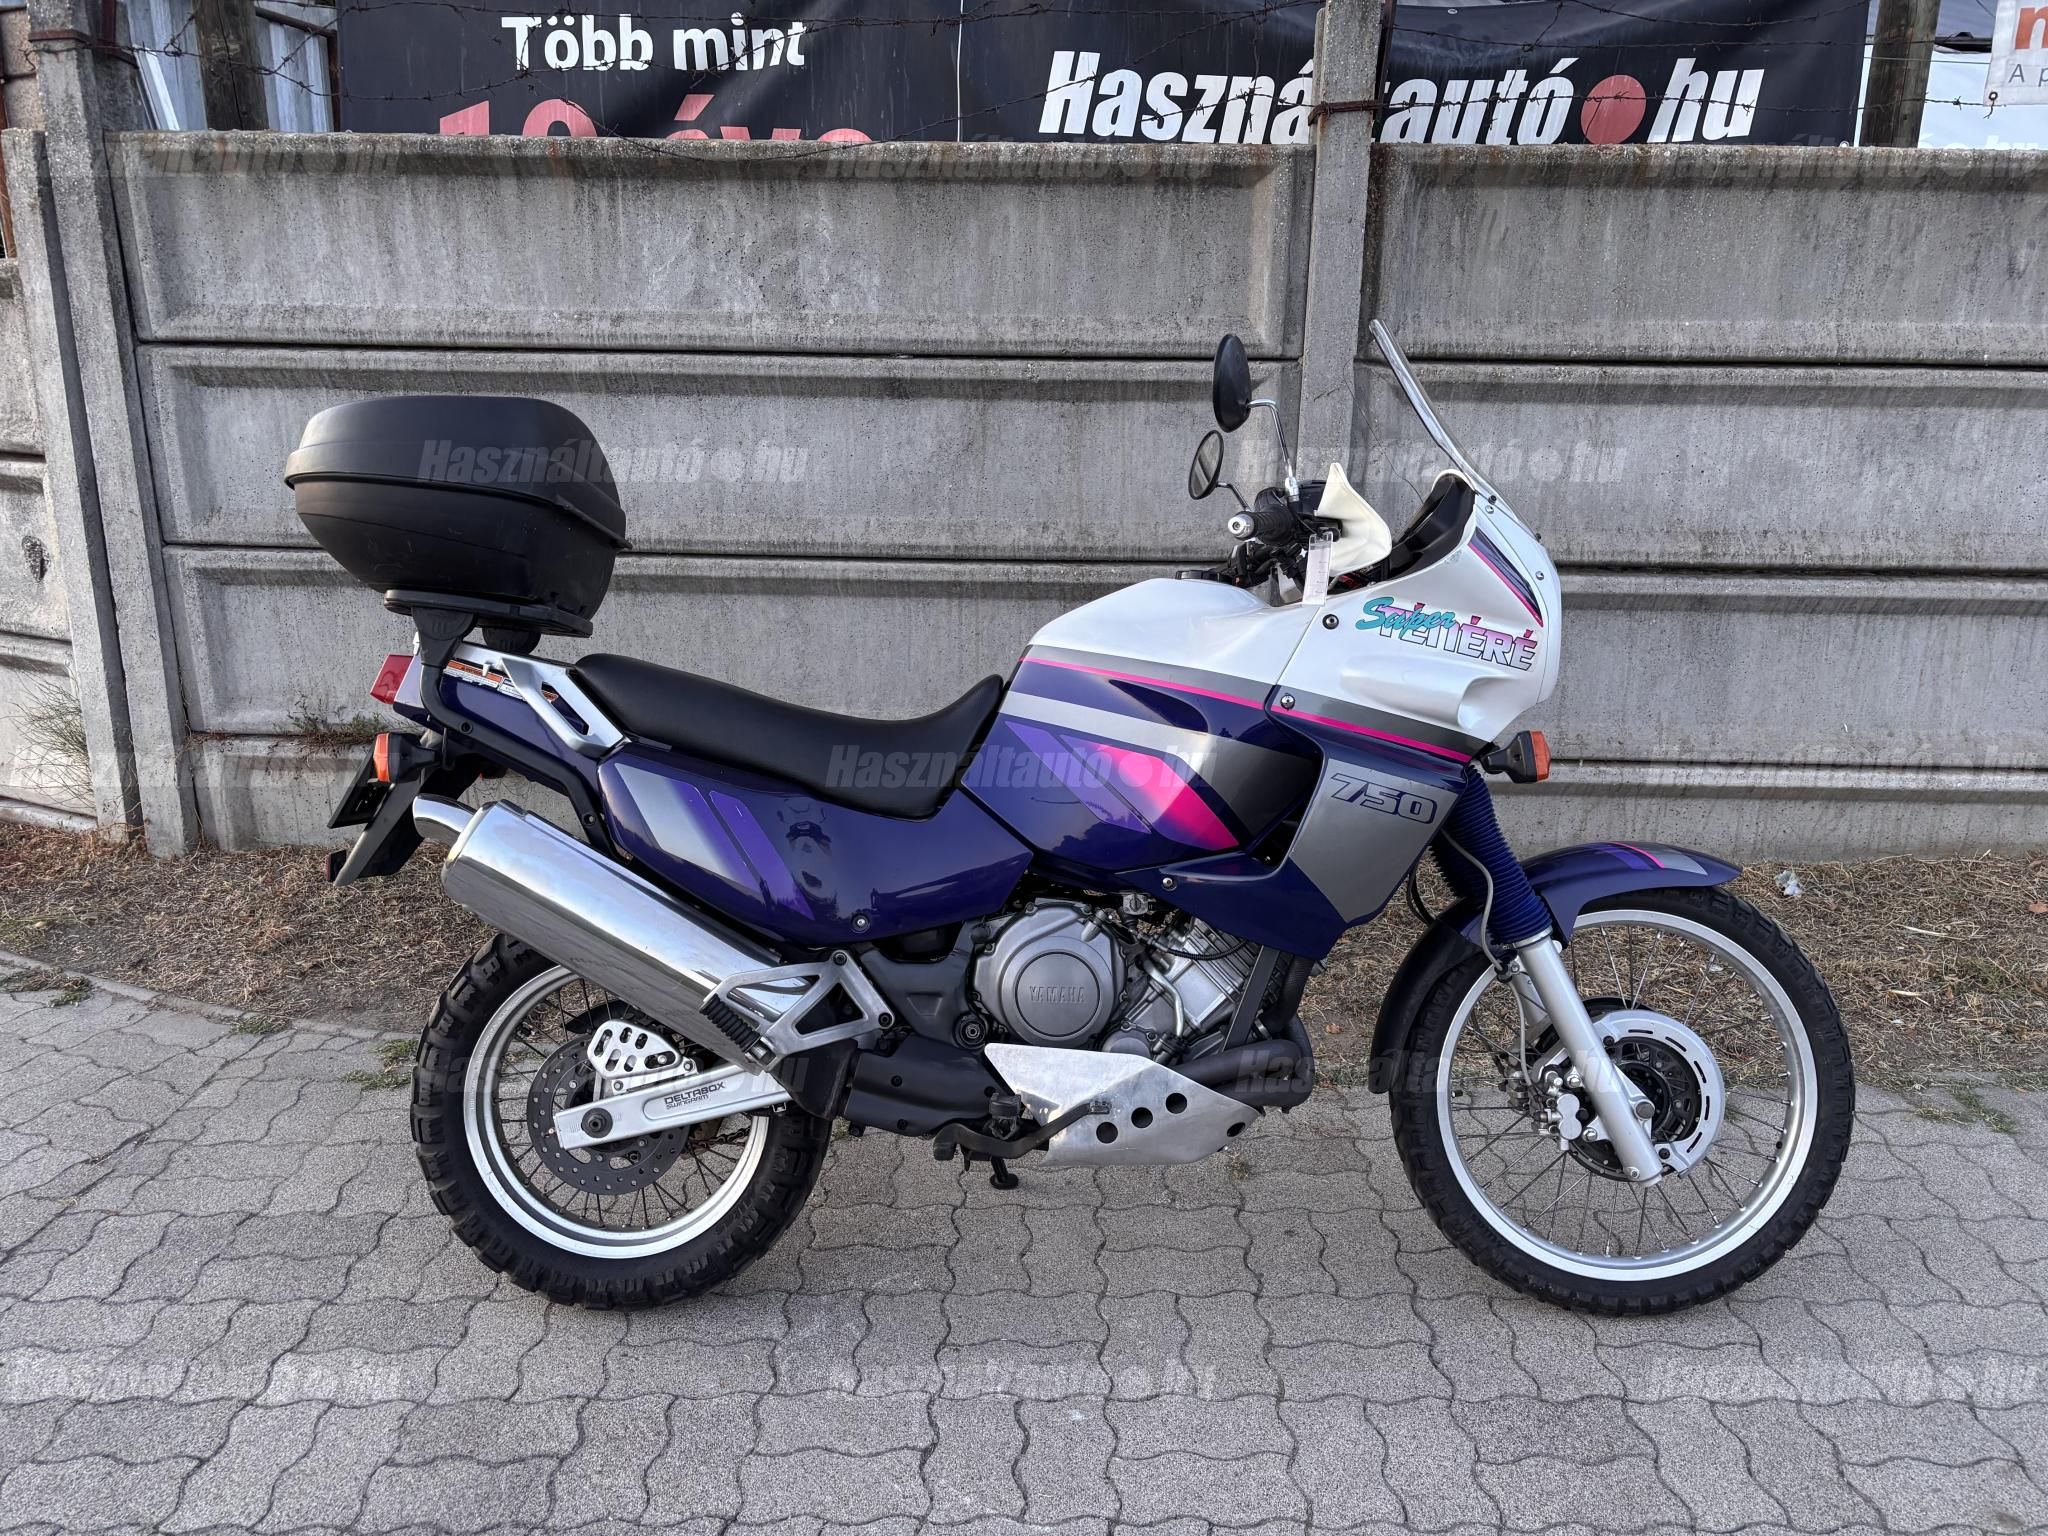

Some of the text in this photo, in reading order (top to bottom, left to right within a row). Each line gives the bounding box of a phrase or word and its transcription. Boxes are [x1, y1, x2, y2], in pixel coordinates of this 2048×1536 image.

[501, 12, 806, 71] Több mint
[1355, 596, 1456, 638] Super
[1330, 773, 1438, 825] 750
[1029, 985, 1087, 1004] YAMAHA
[664, 1081, 726, 1105] DELTABOX
